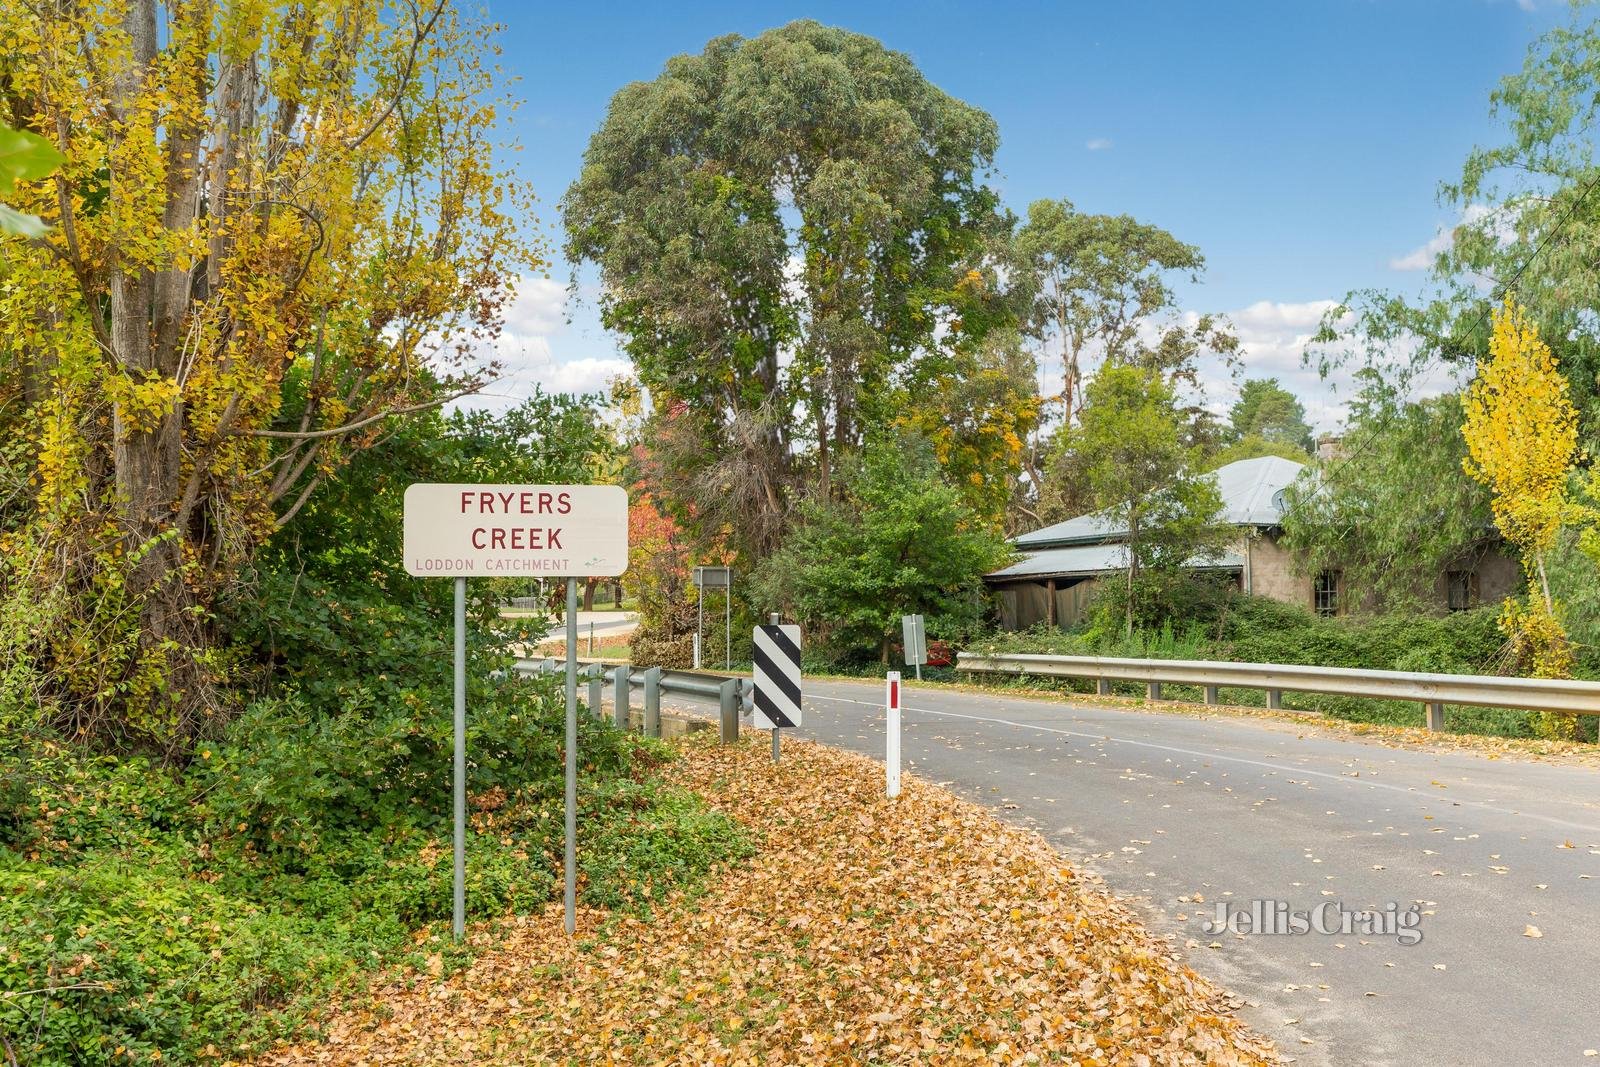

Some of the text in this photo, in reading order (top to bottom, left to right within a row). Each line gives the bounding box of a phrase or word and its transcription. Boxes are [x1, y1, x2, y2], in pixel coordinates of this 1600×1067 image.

[461, 492, 572, 514] FRYERS
[471, 527, 563, 550] CREEK
[415, 559, 570, 571] LODDON CATCHMENT
